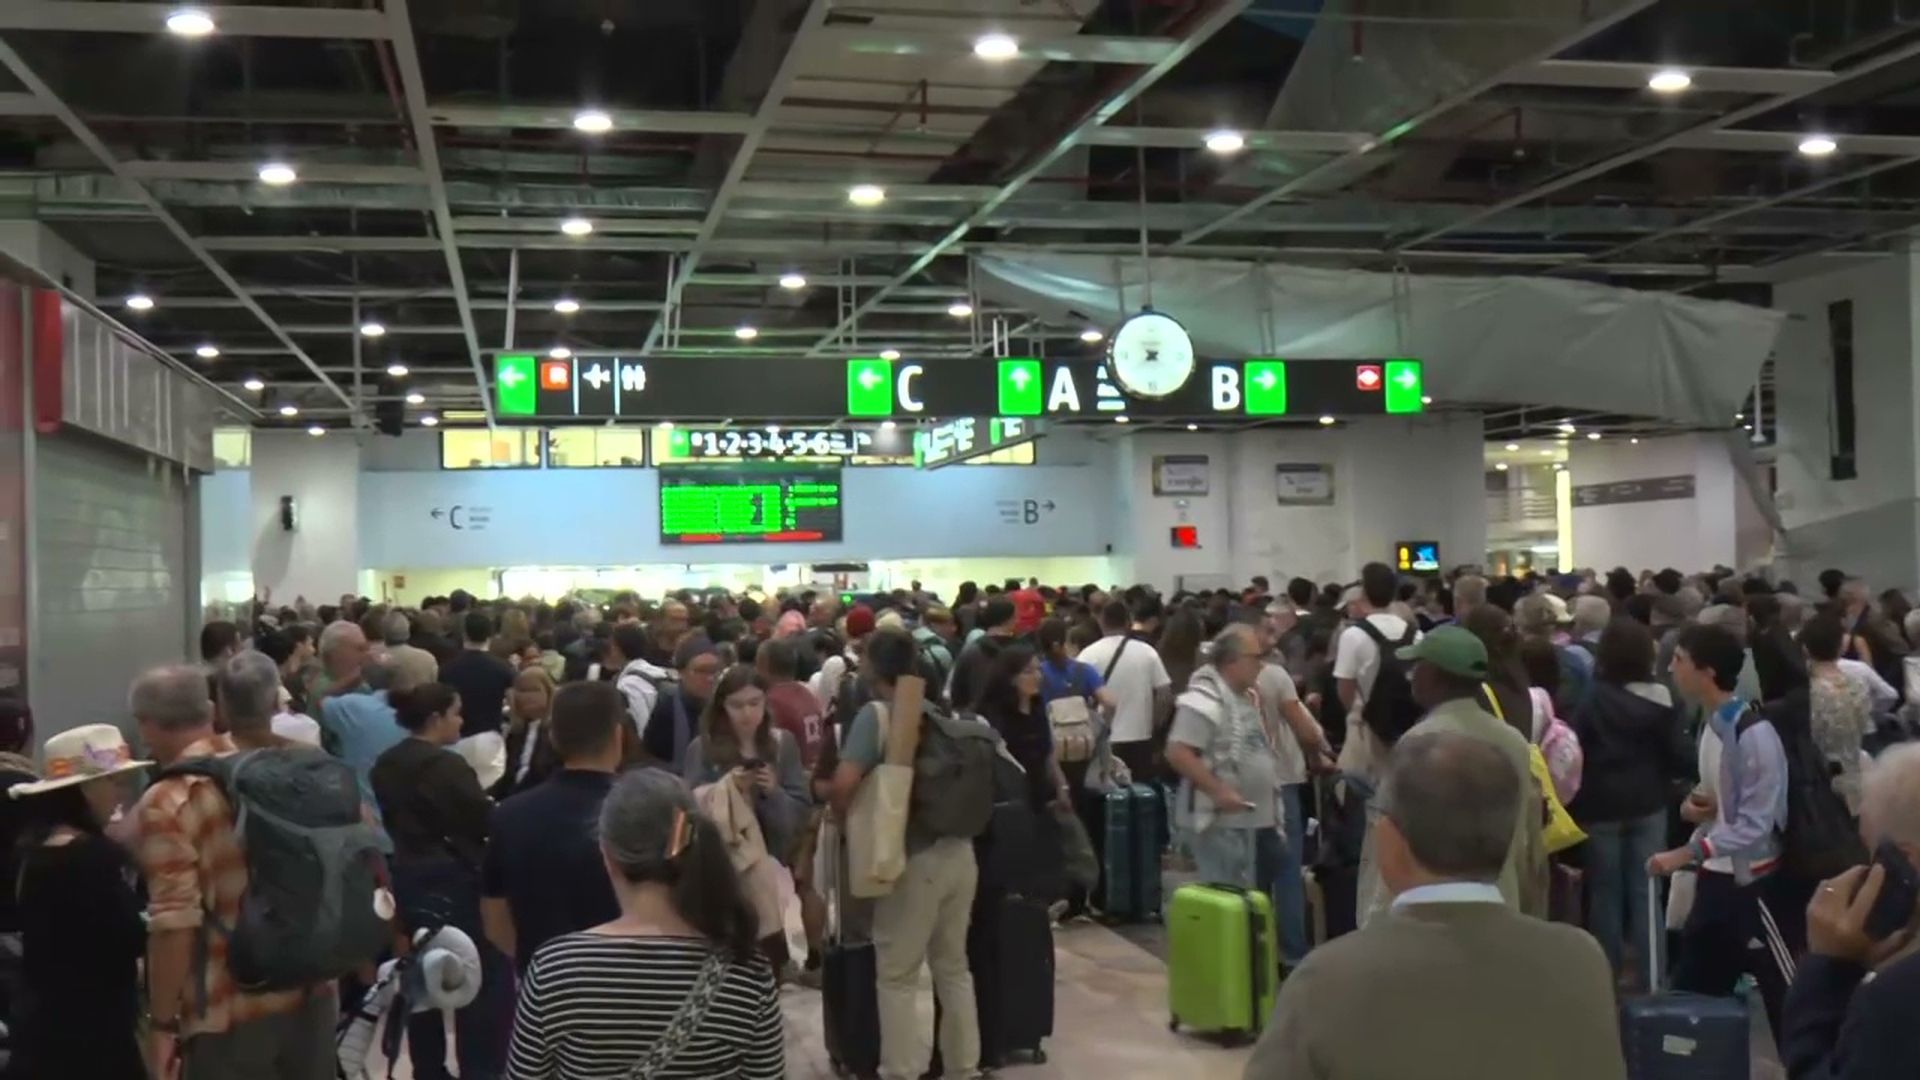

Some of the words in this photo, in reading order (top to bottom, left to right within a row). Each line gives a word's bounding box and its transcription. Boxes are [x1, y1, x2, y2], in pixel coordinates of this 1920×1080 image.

[897, 365, 924, 411] C
[1047, 366, 1081, 412] A
[1211, 366, 1241, 411] B
[449, 504, 463, 530] C
[1024, 499, 1039, 524] B
